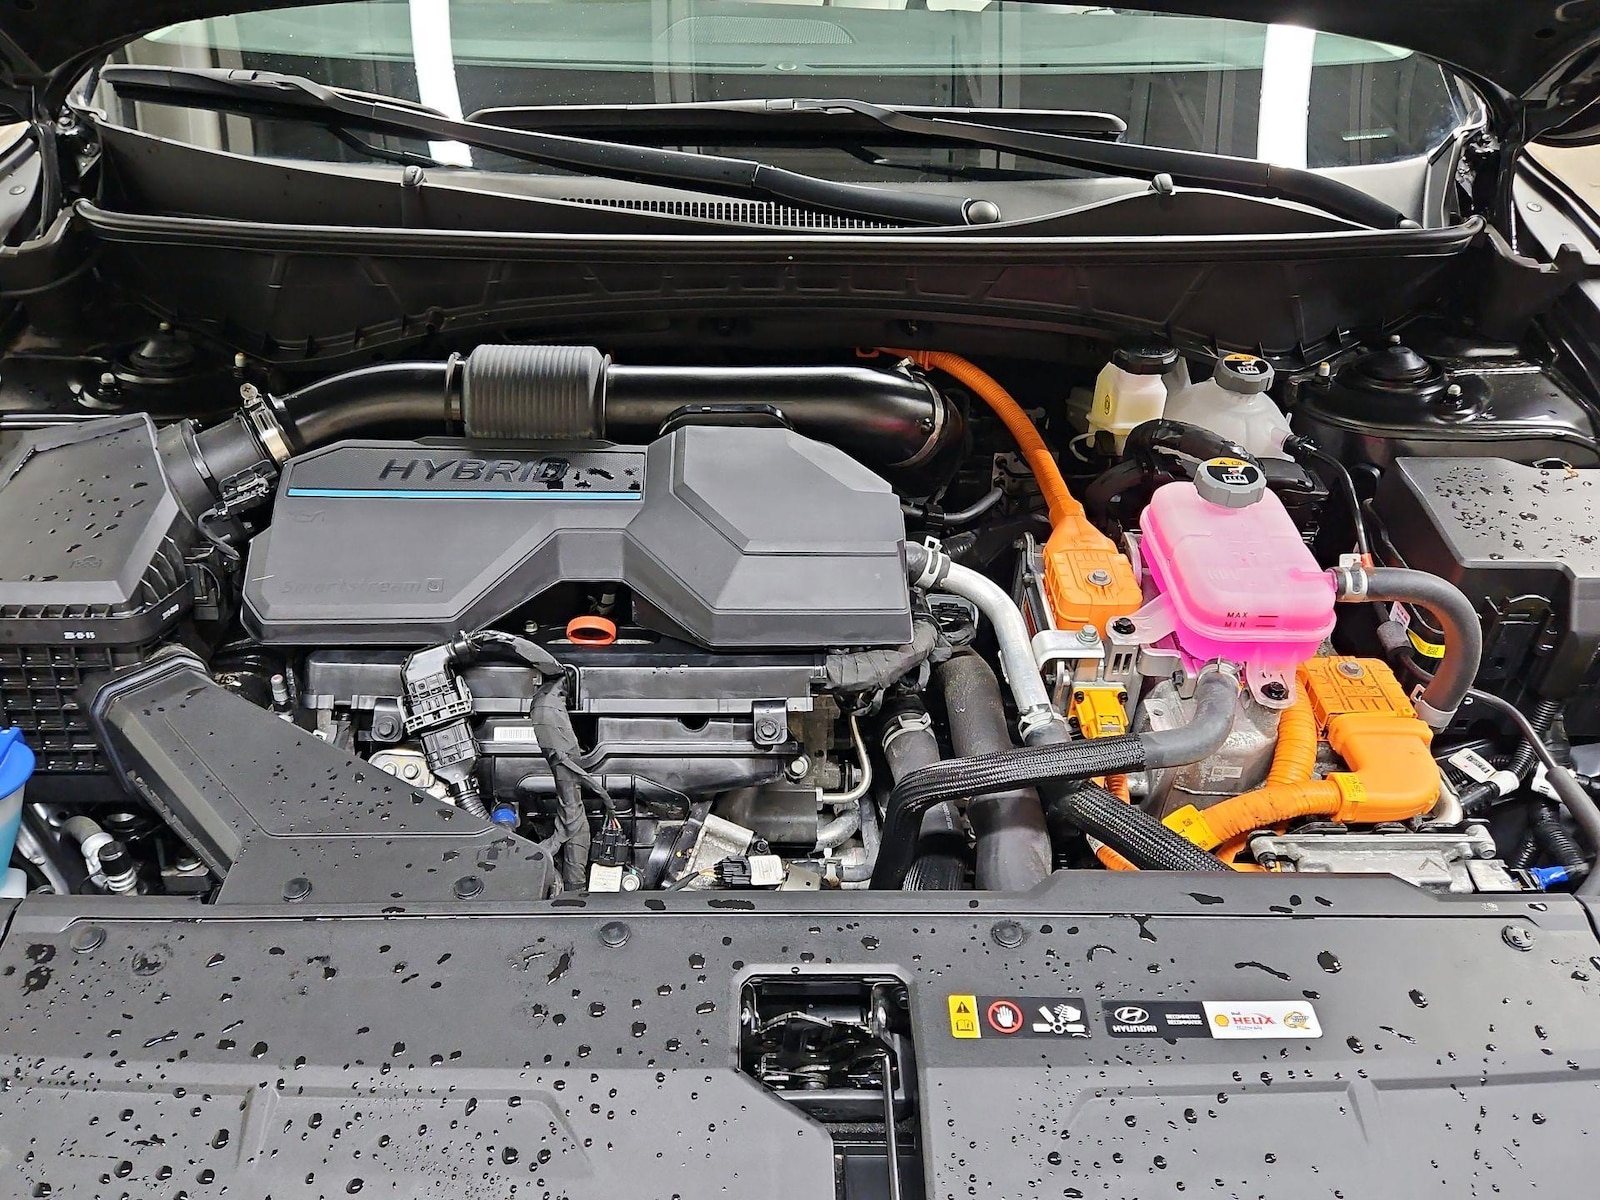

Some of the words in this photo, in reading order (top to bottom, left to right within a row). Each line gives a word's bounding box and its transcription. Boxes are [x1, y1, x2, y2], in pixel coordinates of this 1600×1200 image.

[378, 458, 570, 482] HYBRID
[1233, 1016, 1274, 1025] HELIX
[1112, 1025, 1158, 1033] HYUNDAI
